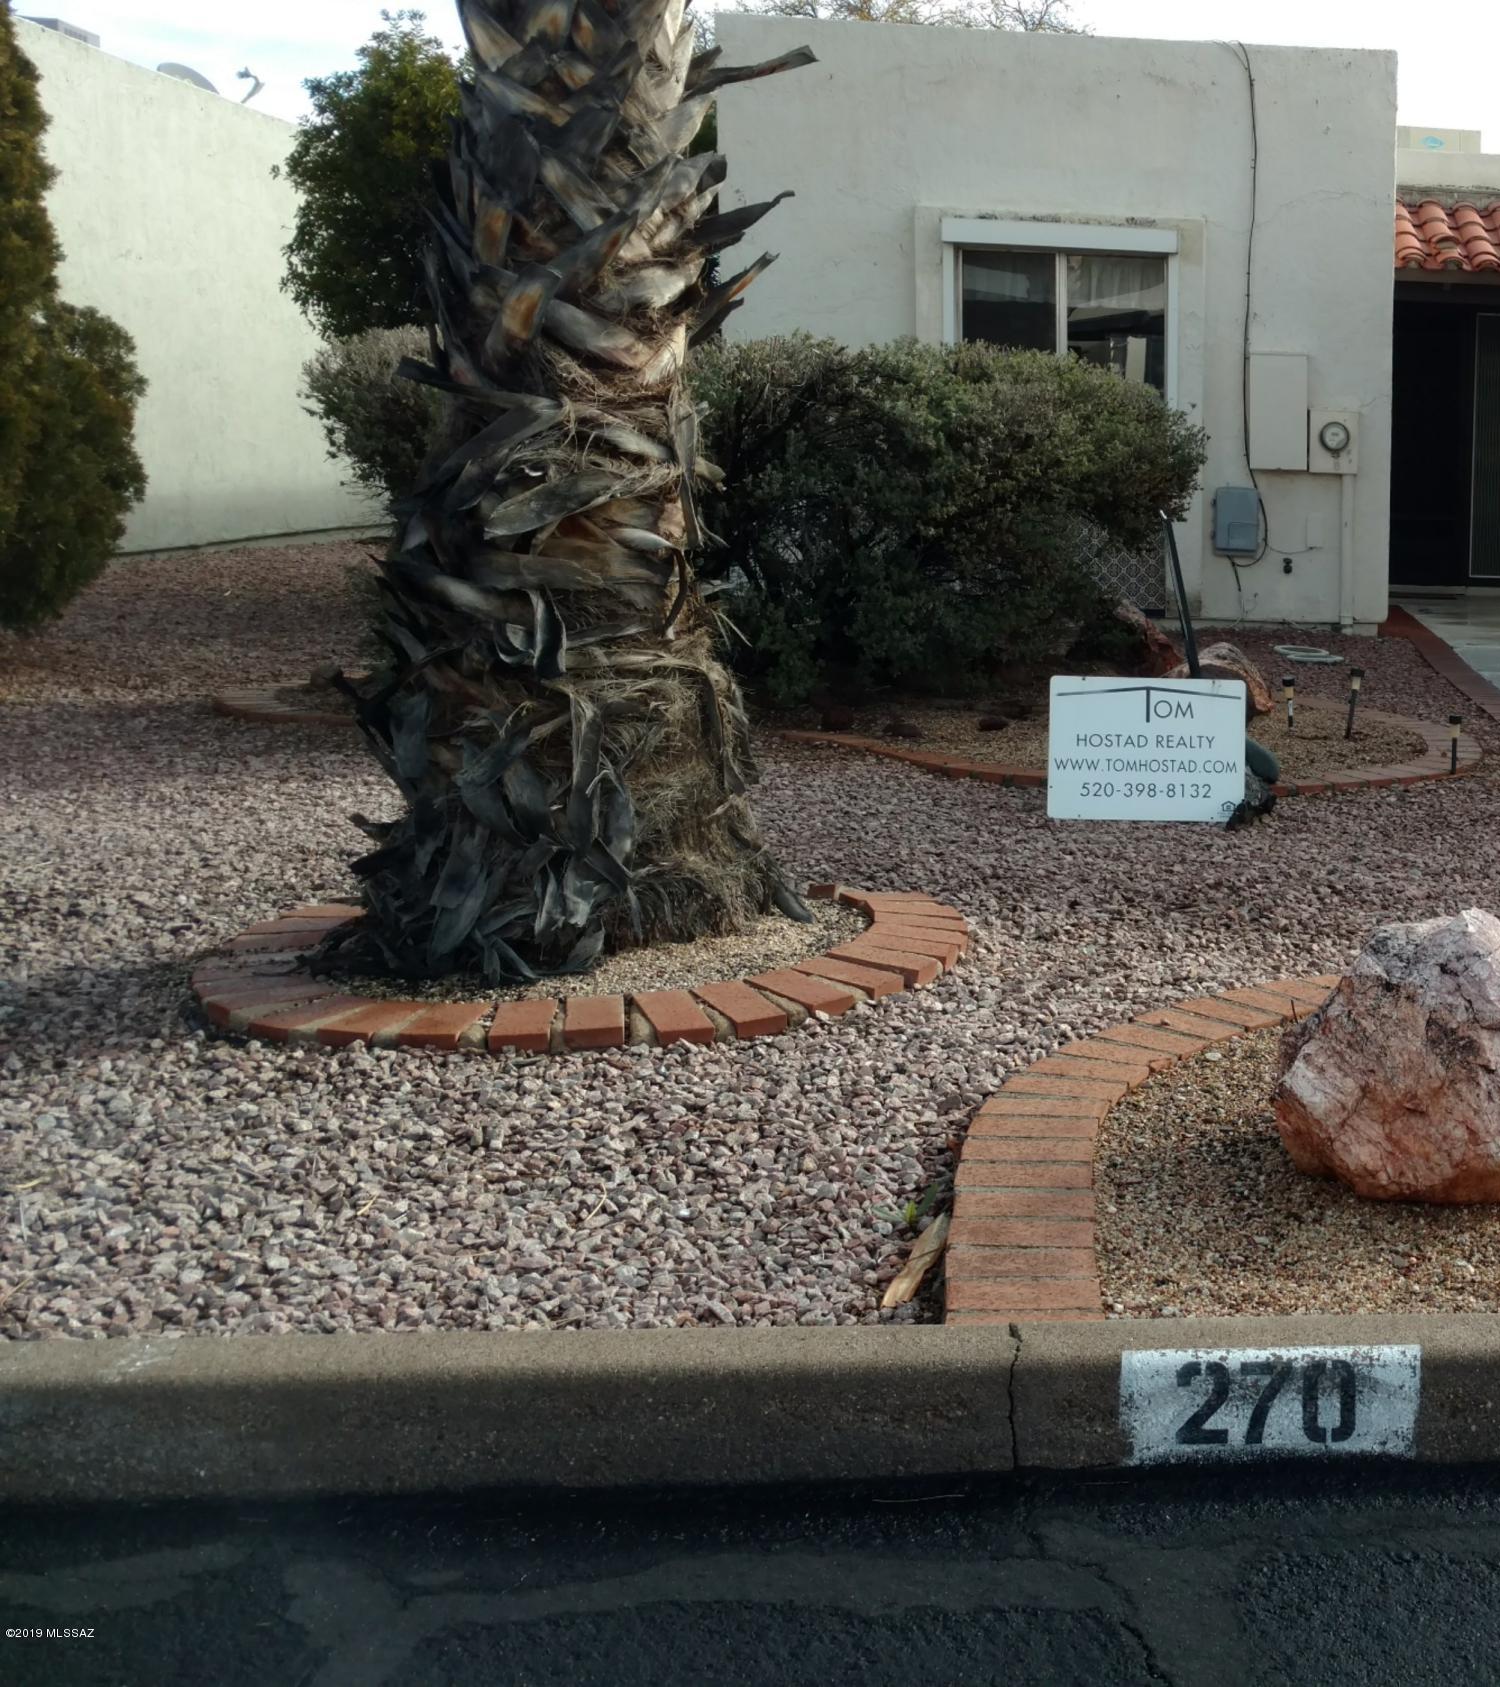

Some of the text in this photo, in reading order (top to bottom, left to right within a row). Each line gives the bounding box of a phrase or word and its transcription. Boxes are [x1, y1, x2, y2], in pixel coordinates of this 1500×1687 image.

[1076, 733, 1216, 750] HOSTAD REALTY
[1054, 757, 1237, 774] WWW.TOMHOSTAD.COM
[1080, 782, 1212, 799] 520-398-8132
[1175, 1359, 1357, 1446] 270
